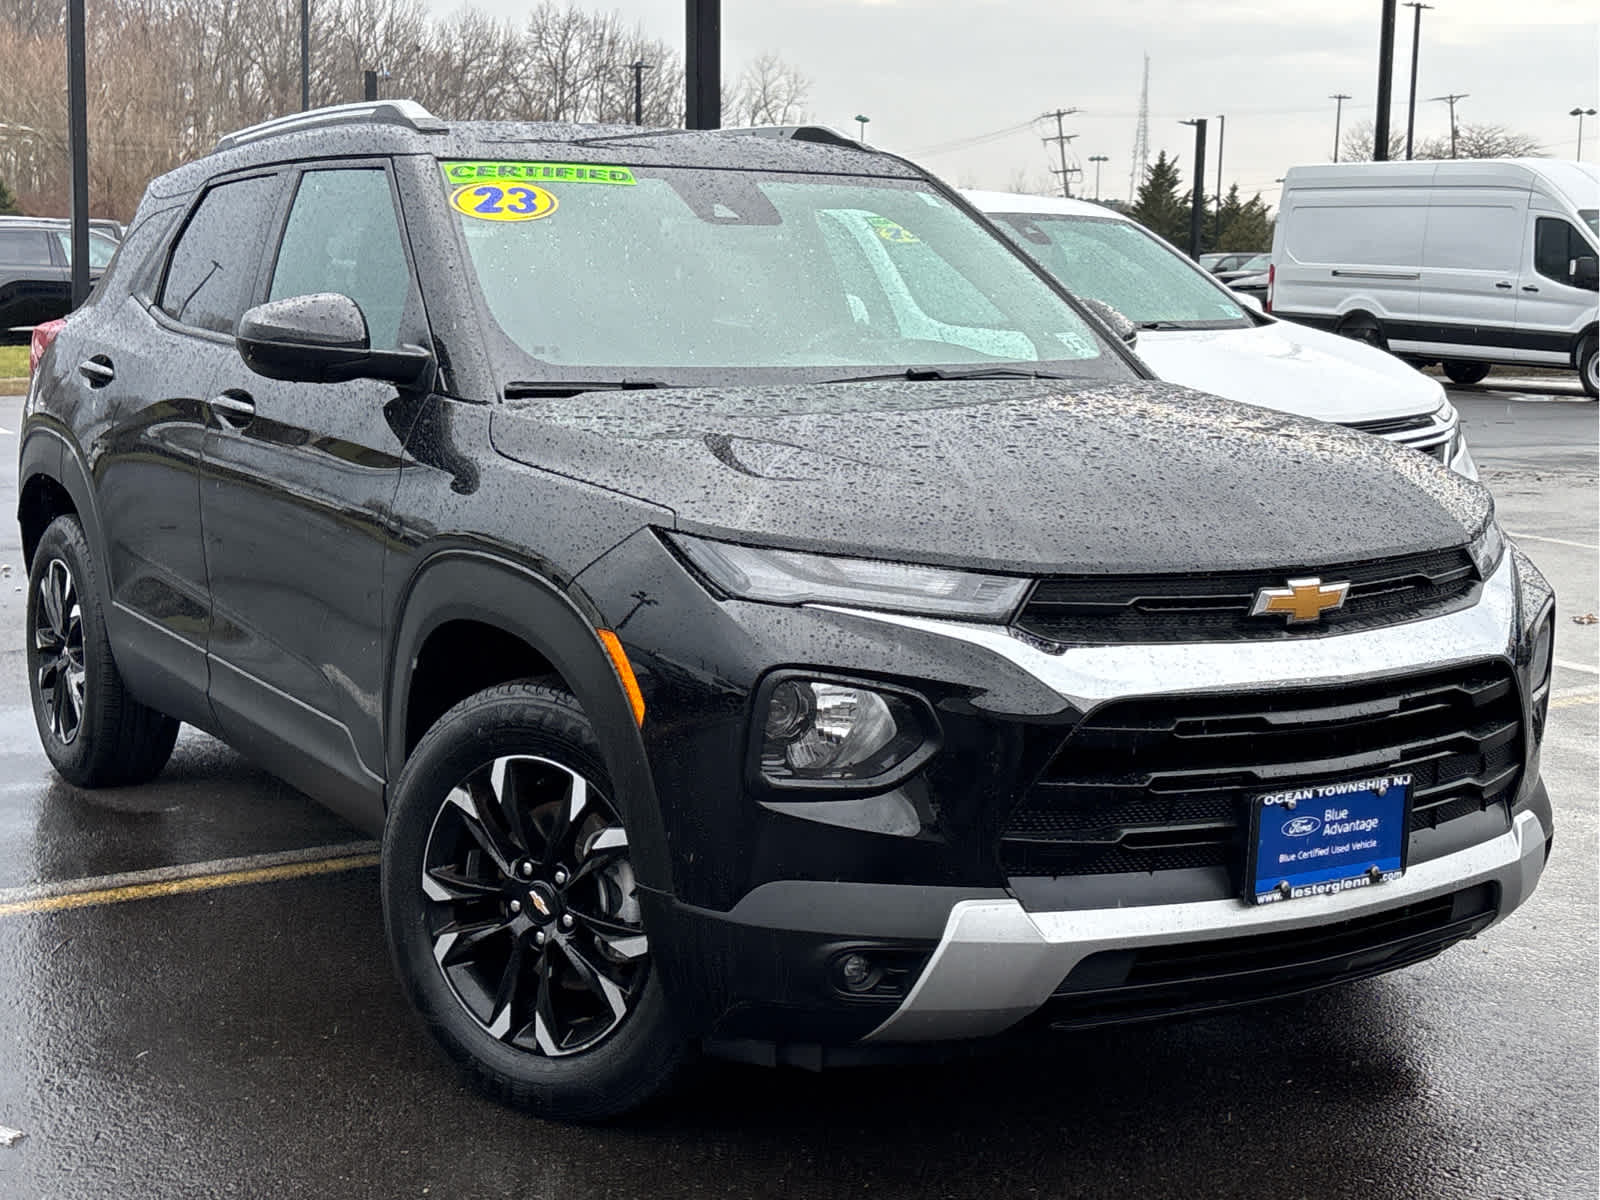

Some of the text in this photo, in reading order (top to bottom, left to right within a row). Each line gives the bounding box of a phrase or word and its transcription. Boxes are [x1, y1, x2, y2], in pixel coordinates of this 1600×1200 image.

[450, 165, 630, 181] CERTIFIED
[473, 186, 538, 213] 23
[1264, 775, 1412, 806] OCEAN TOWNSHIP NJ
[1324, 808, 1349, 822] Blue
[1322, 817, 1379, 836] Advantage
[1278, 839, 1377, 863] Blue Certified Used Vehicle
